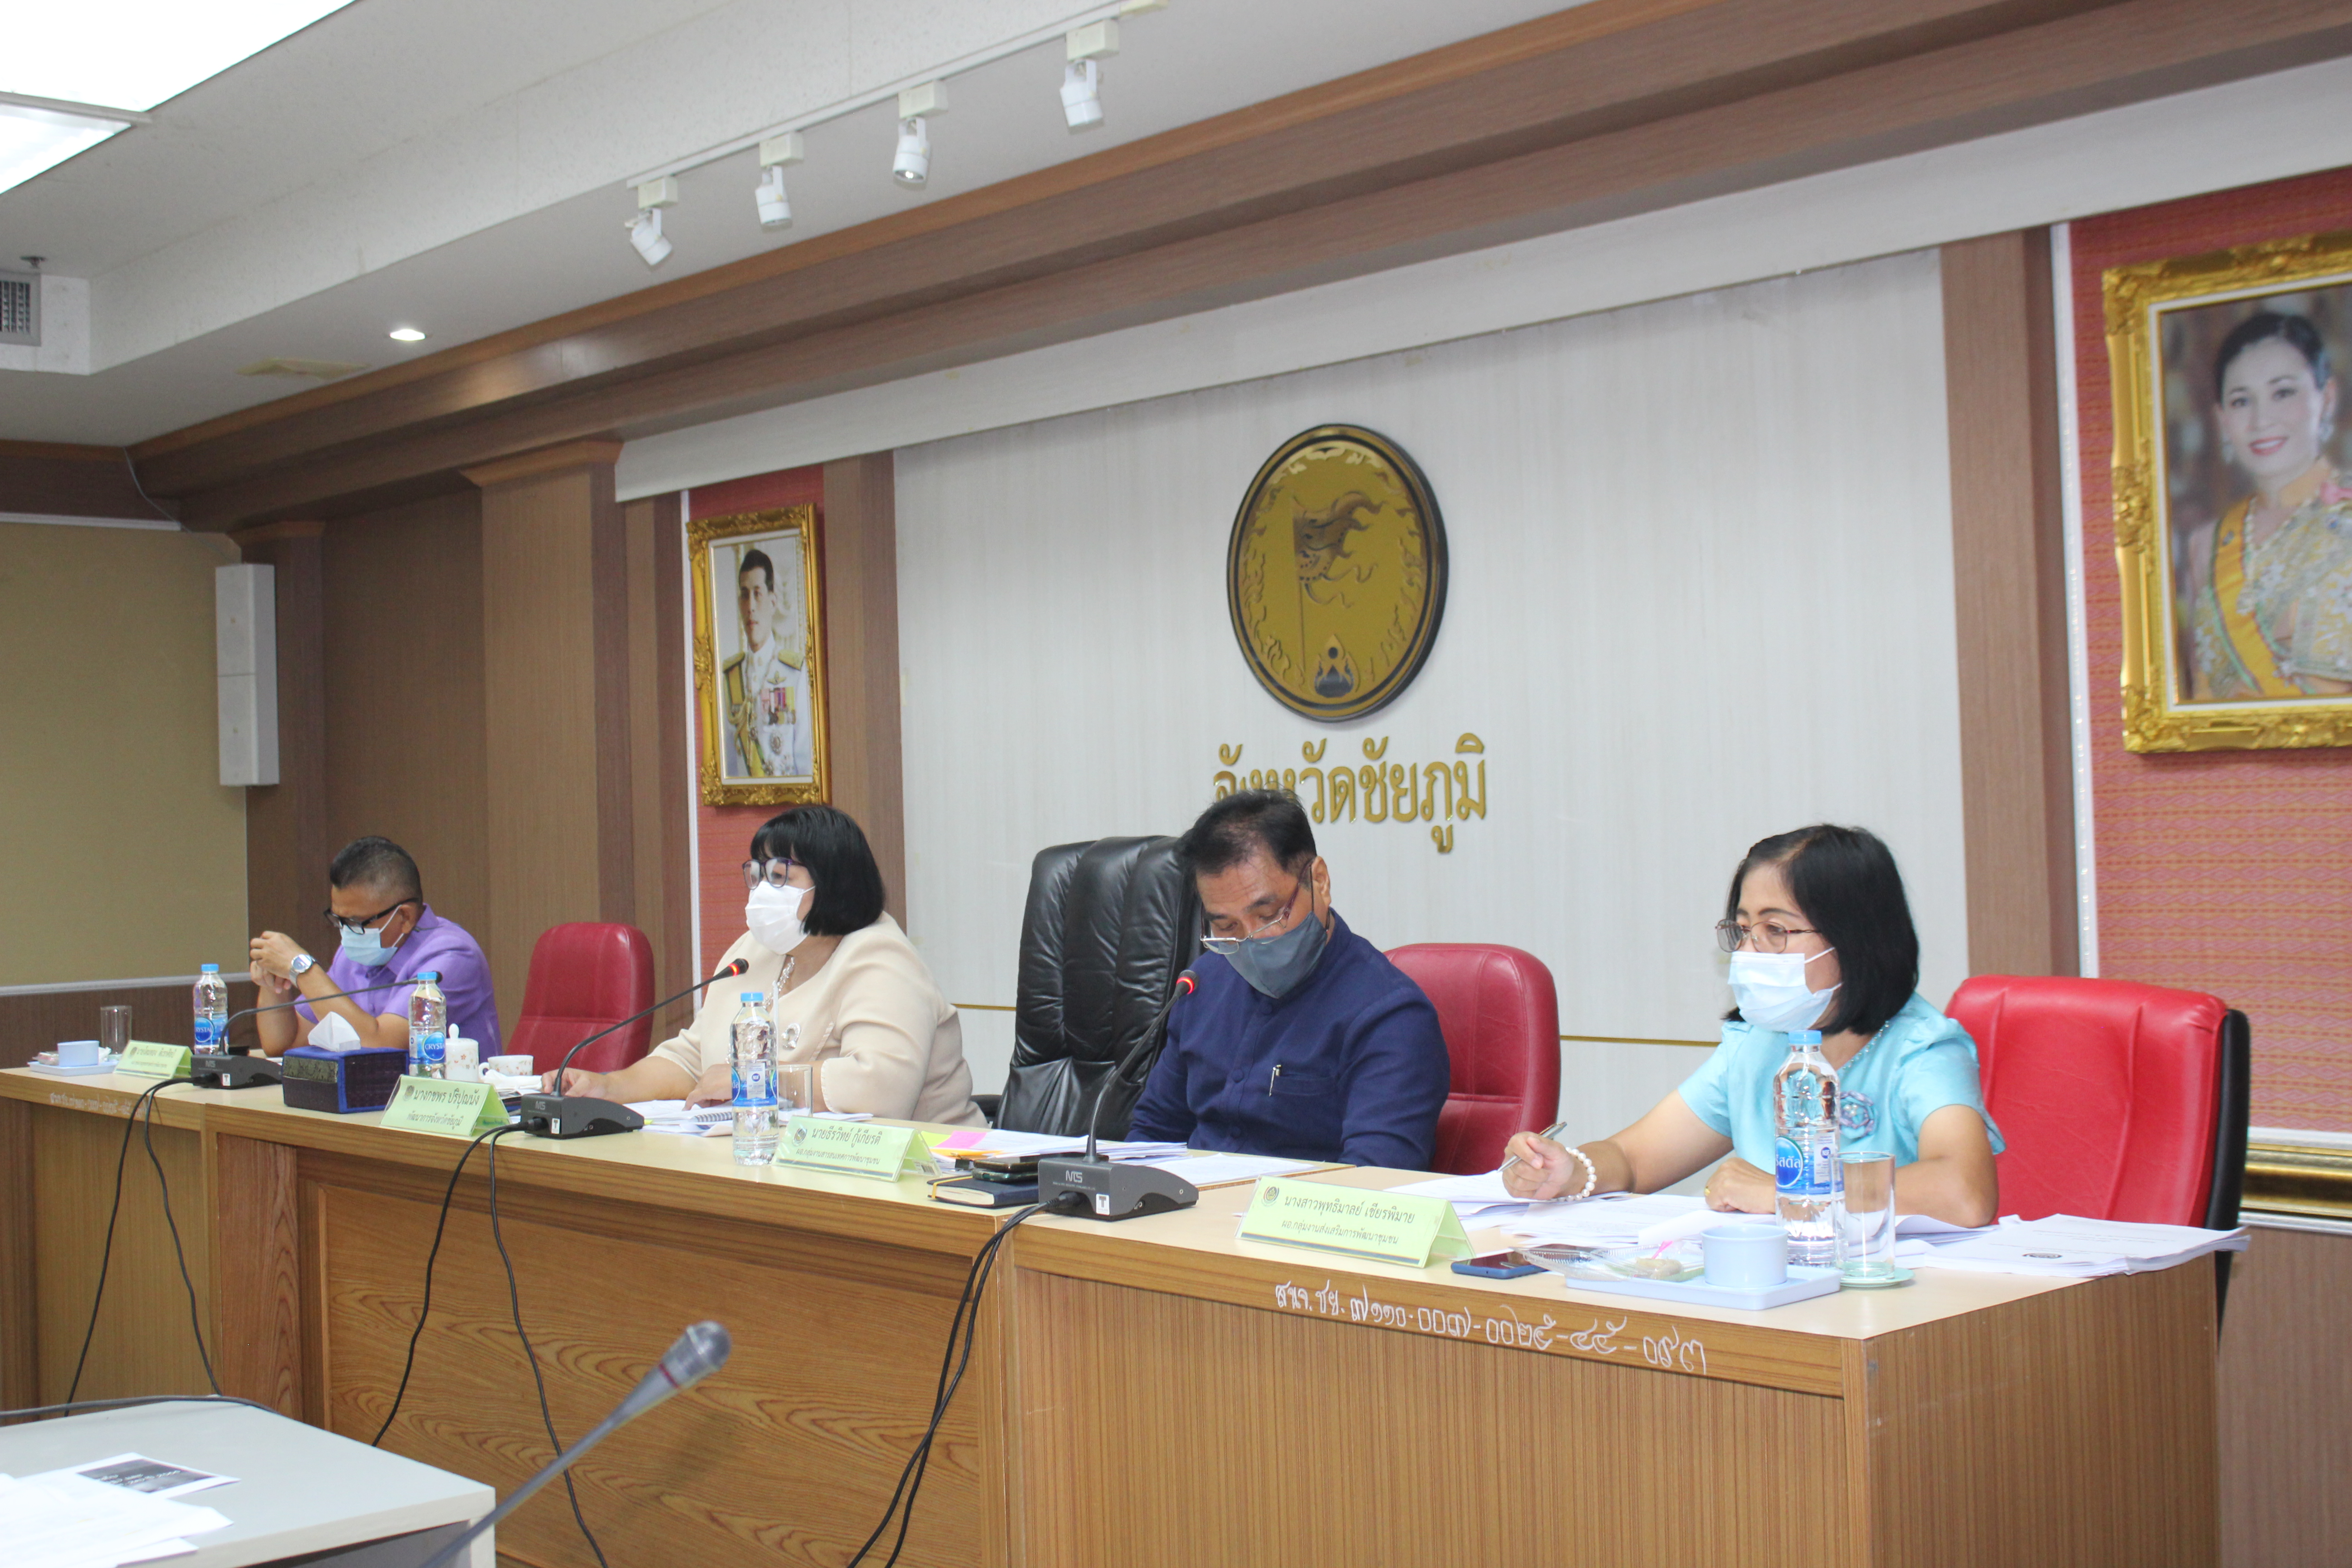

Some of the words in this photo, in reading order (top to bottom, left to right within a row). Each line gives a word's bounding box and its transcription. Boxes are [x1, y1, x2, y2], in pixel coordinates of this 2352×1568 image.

[1213, 733, 1486, 853] จัวัดชัยภูมิ
[812, 1126, 854, 1142] นายธีรวิทย์
[851, 1128, 883, 1148] กู้เกียรติ
[1284, 1196, 1365, 1216] นางสาวพุทธิมาลย์
[1365, 1203, 1415, 1224] เชียรพิมาย
[1282, 1220, 1399, 1246] ผอ.กลุ่มงานส่งเสริมการพัฒนาชุมชน
